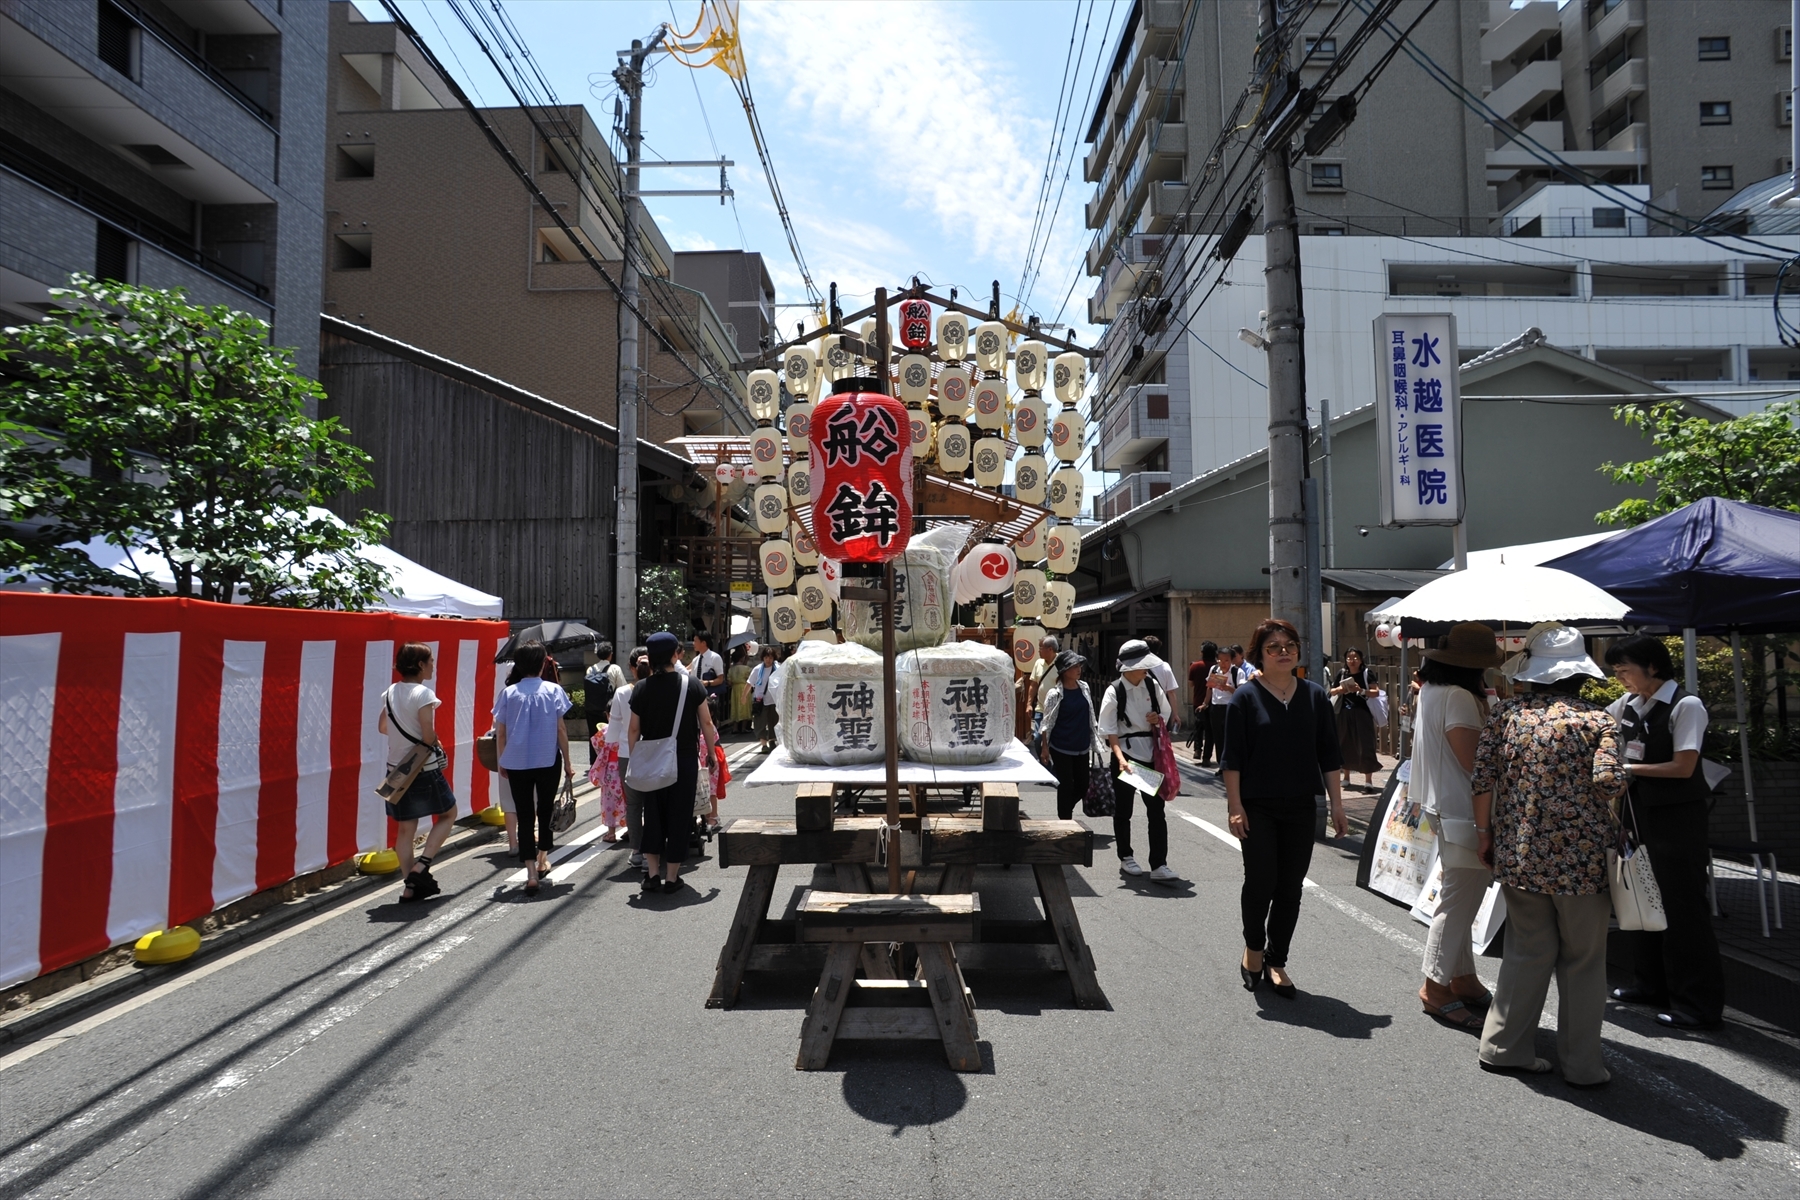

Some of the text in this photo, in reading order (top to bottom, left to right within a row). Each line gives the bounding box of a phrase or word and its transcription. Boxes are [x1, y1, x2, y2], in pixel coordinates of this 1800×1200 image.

[1391, 330, 1411, 486] 耳鼻咽喉科・アレルギー科
[1412, 332, 1448, 505] 水越医院
[827, 681, 878, 753] 神聖
[941, 677, 993, 748] 神聖
